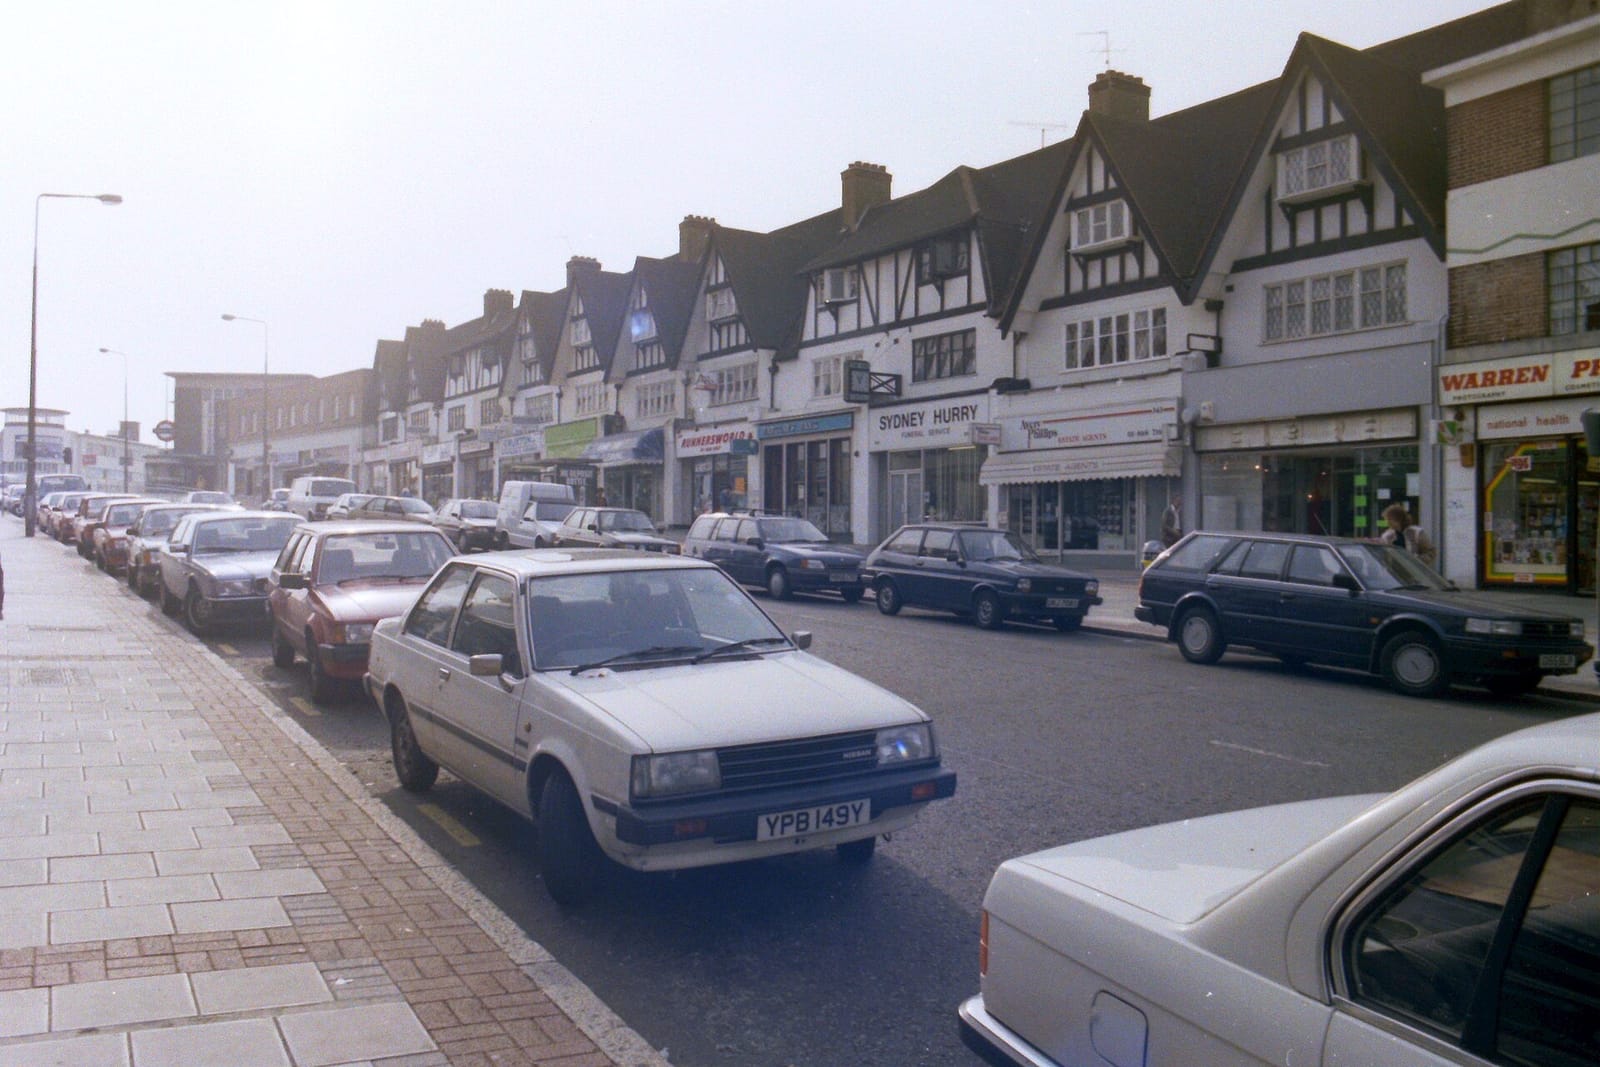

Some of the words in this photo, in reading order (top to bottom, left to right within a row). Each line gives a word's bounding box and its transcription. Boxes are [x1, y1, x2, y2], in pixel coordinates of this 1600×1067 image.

[1441, 365, 1551, 392] WARREN
[879, 411, 926, 431] SYDNEY
[933, 405, 978, 425] HURRY
[1487, 416, 1528, 430] national
[1536, 414, 1570, 426] health
[901, 429, 924, 438] FUNERAL
[928, 427, 950, 436] SERVICE
[1058, 435, 1080, 443] ESTATE
[1082, 432, 1107, 441] AGENTS
[1033, 464, 1060, 472] ESTATE
[1064, 461, 1099, 470] AGENTS
[842, 749, 872, 759] NISSAN
[766, 812, 809, 837] YPB
[815, 802, 865, 828] 149Y
